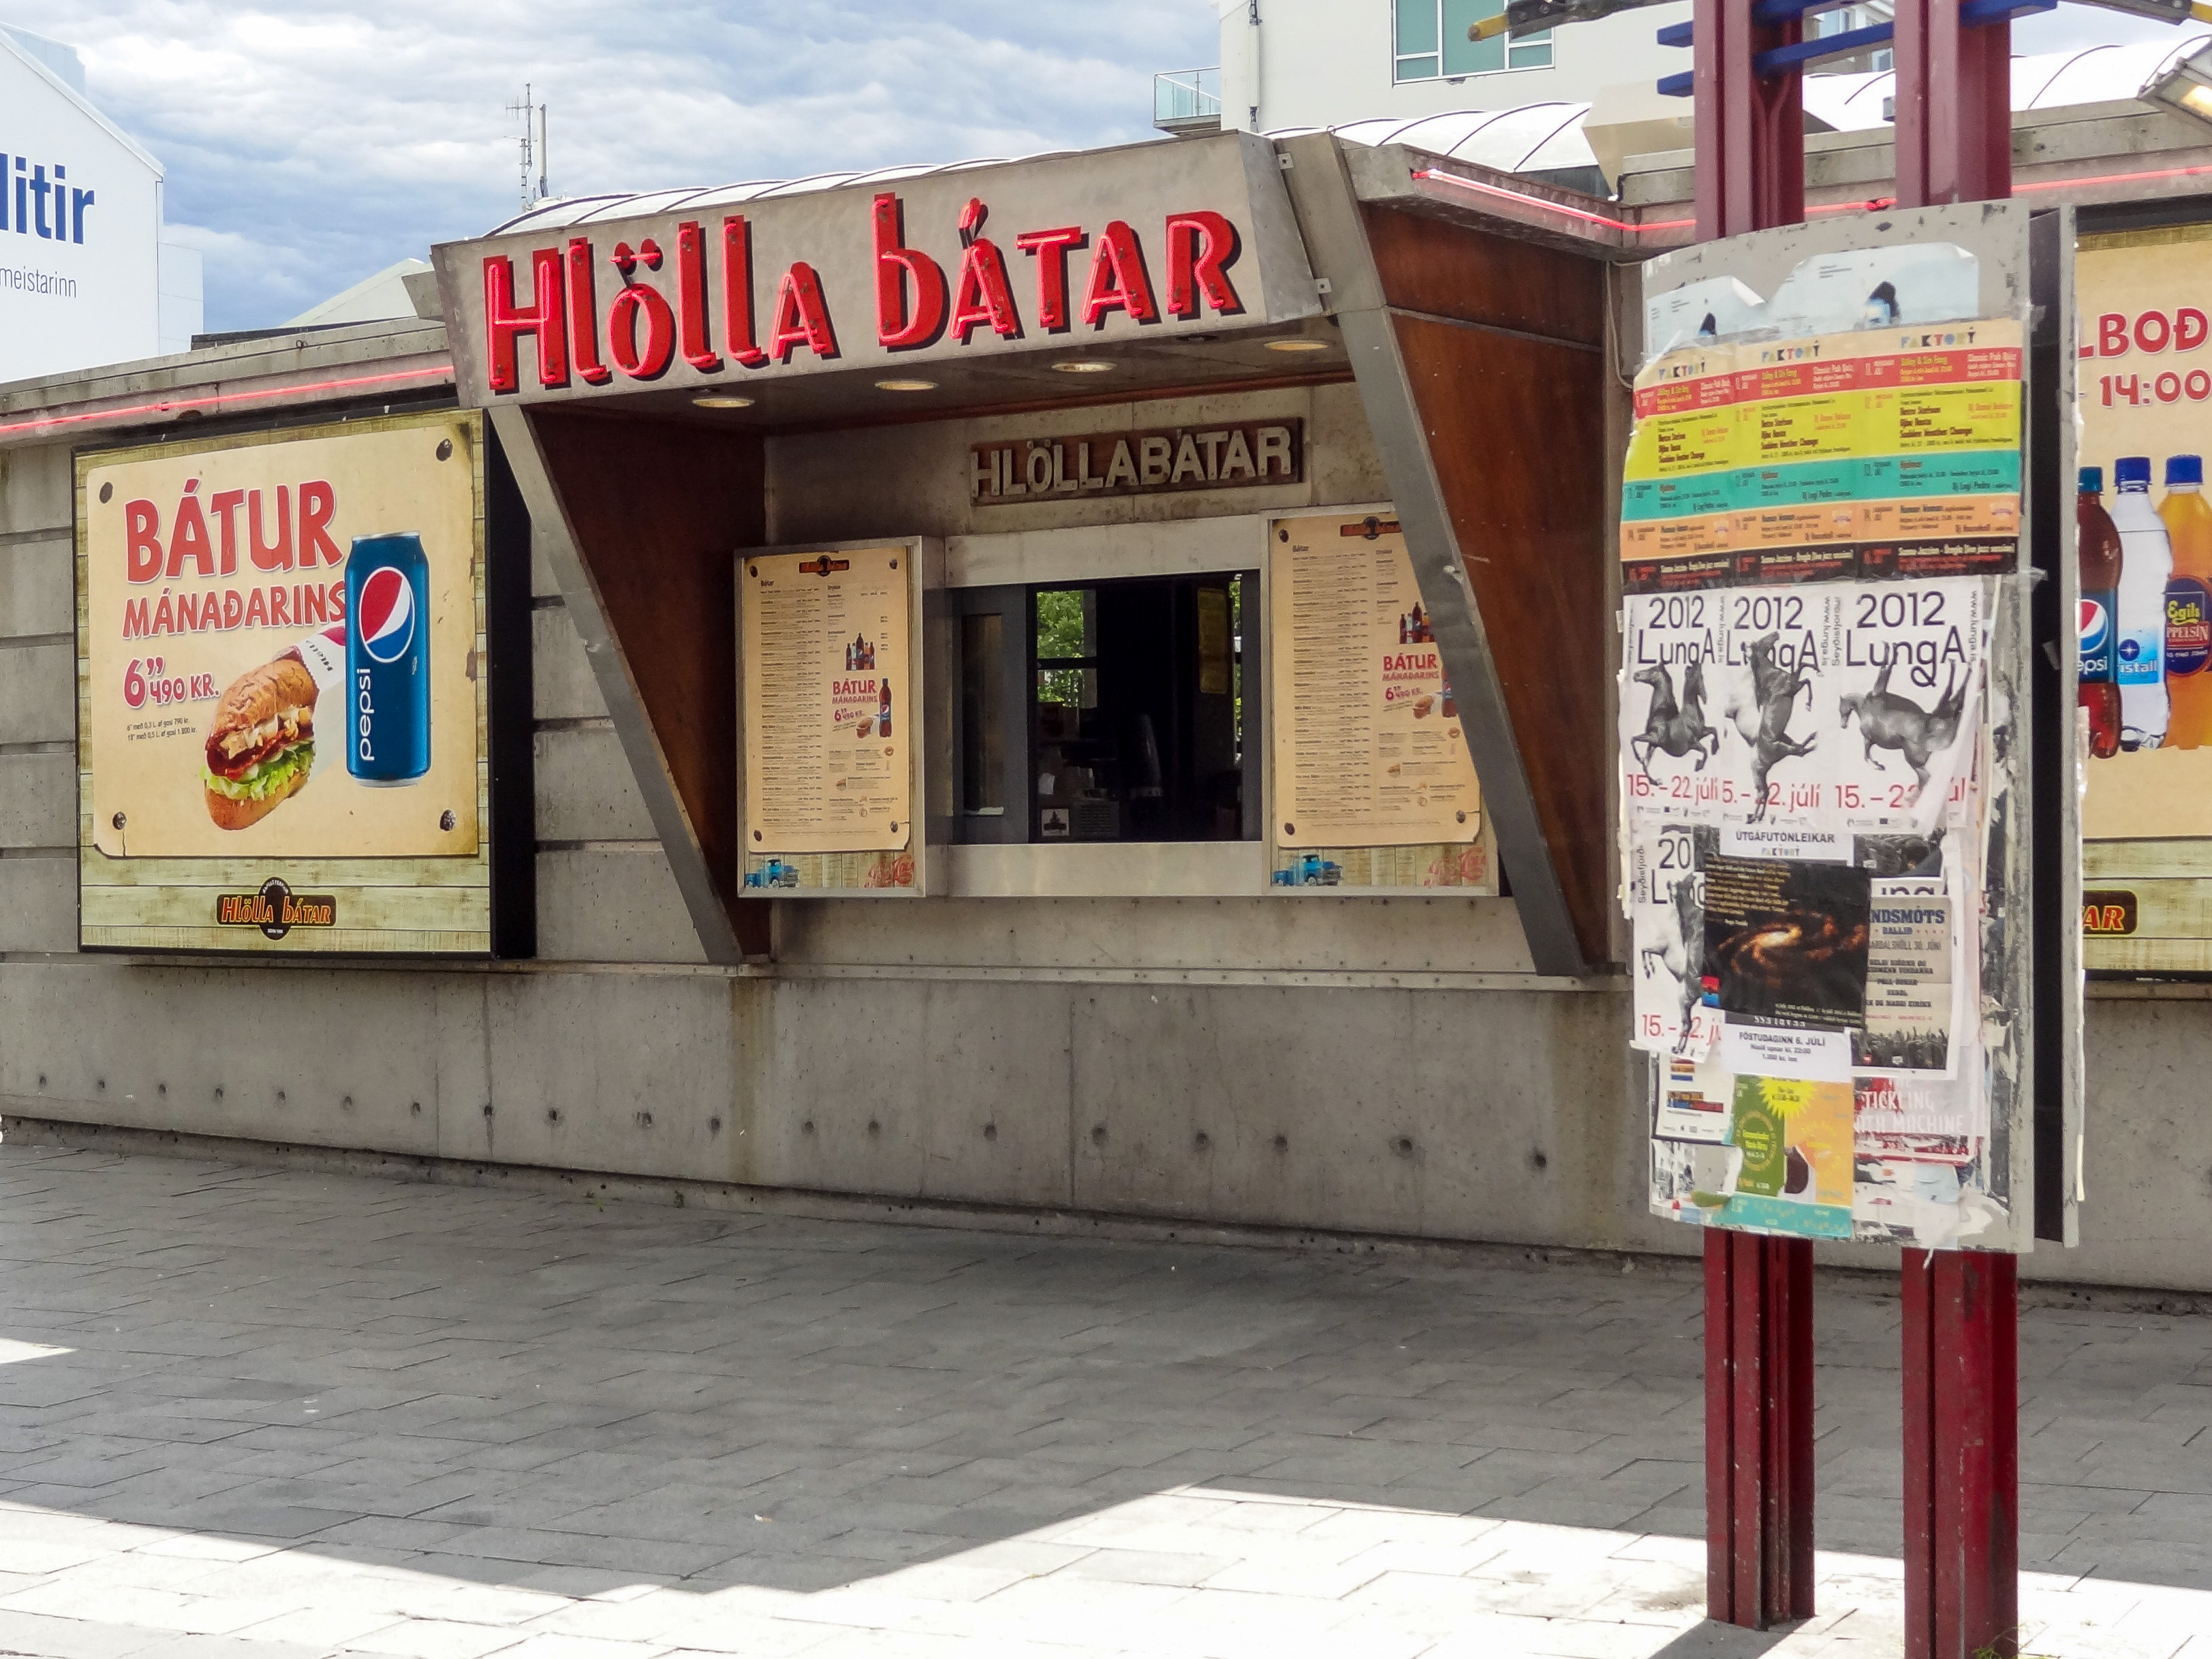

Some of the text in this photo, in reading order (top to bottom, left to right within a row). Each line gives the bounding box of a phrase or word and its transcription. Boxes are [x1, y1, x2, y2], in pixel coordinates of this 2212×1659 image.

[0, 266, 76, 298] meistarinn
[2099, 369, 2211, 408] 14:00
[970, 426, 1292, 497] HLÖLLABÁTAR
[125, 478, 343, 584] BÁTUR
[122, 580, 345, 639] MÁNAÐARINS
[1649, 595, 1704, 628] 2012
[1734, 596, 1803, 630] 2012
[1856, 591, 1945, 628] 2012
[1383, 652, 1437, 670] BÁTUR
[1846, 625, 1966, 687] LungA
[149, 676, 186, 704] 490
[190, 672, 220, 700] KR.
[833, 678, 877, 694] BÁTUR
[356, 668, 375, 761] pepsi
[1755, 782, 1786, 806] 2.
[1835, 785, 1865, 808] 15.
[2082, 905, 2125, 931] AR
[1642, 1014, 1664, 1036] 15.
